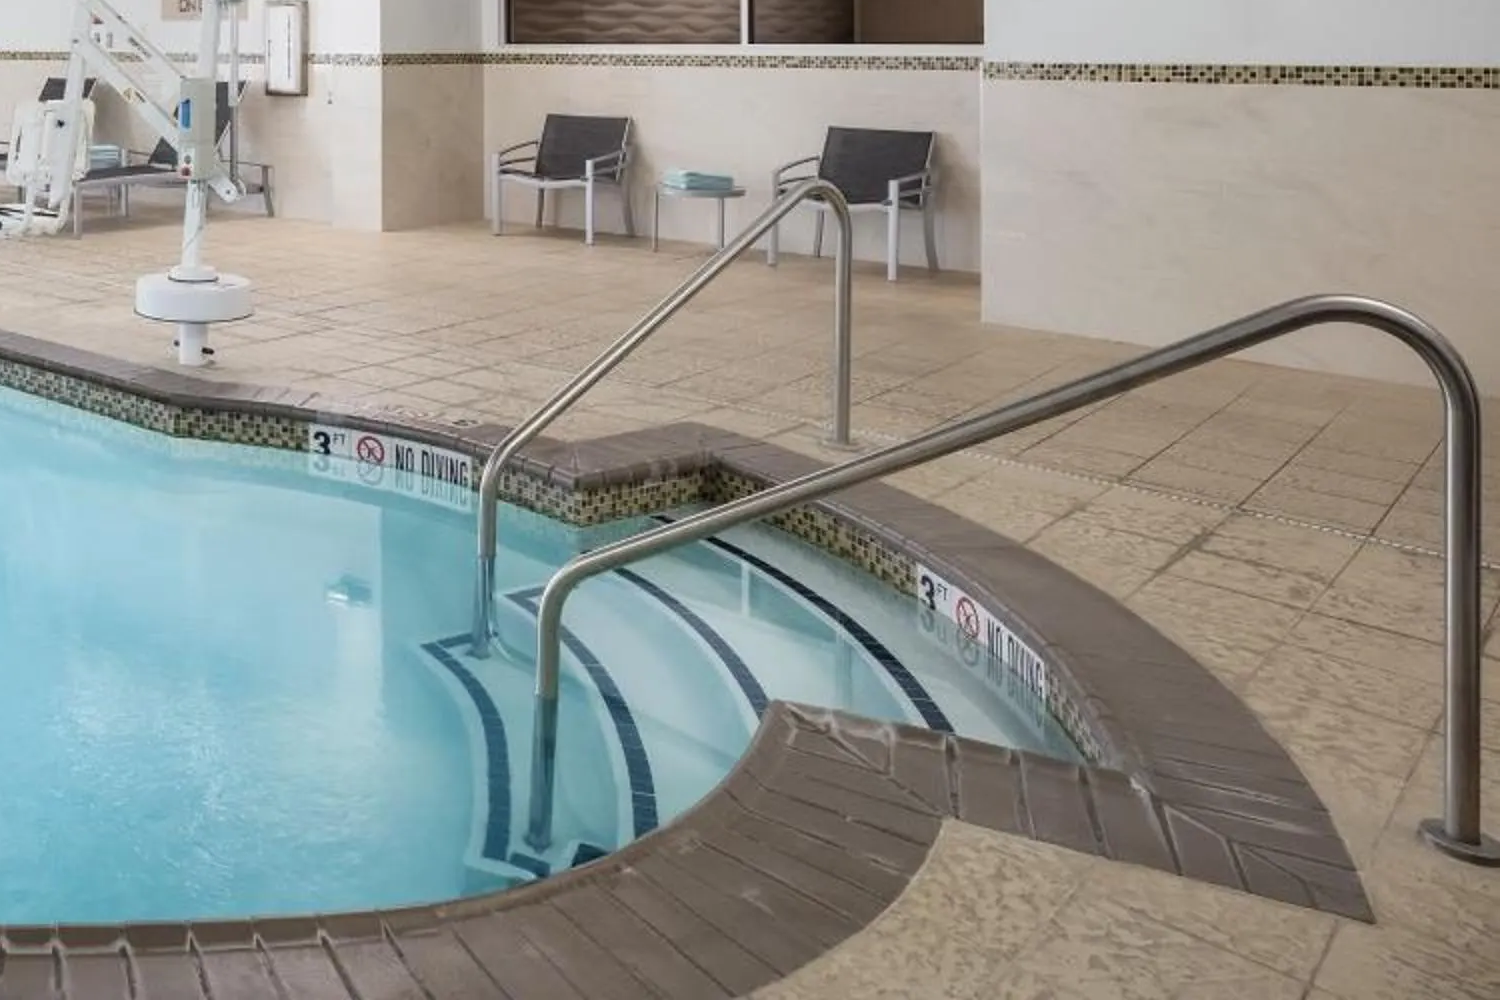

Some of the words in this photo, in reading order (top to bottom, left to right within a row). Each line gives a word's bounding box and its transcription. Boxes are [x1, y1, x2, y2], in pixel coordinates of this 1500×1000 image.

[313, 431, 331, 455] 3
[333, 433, 346, 445] FT
[395, 444, 415, 473] NO
[421, 450, 469, 489] DIVING
[921, 574, 936, 611] 3
[987, 617, 1003, 664] NO
